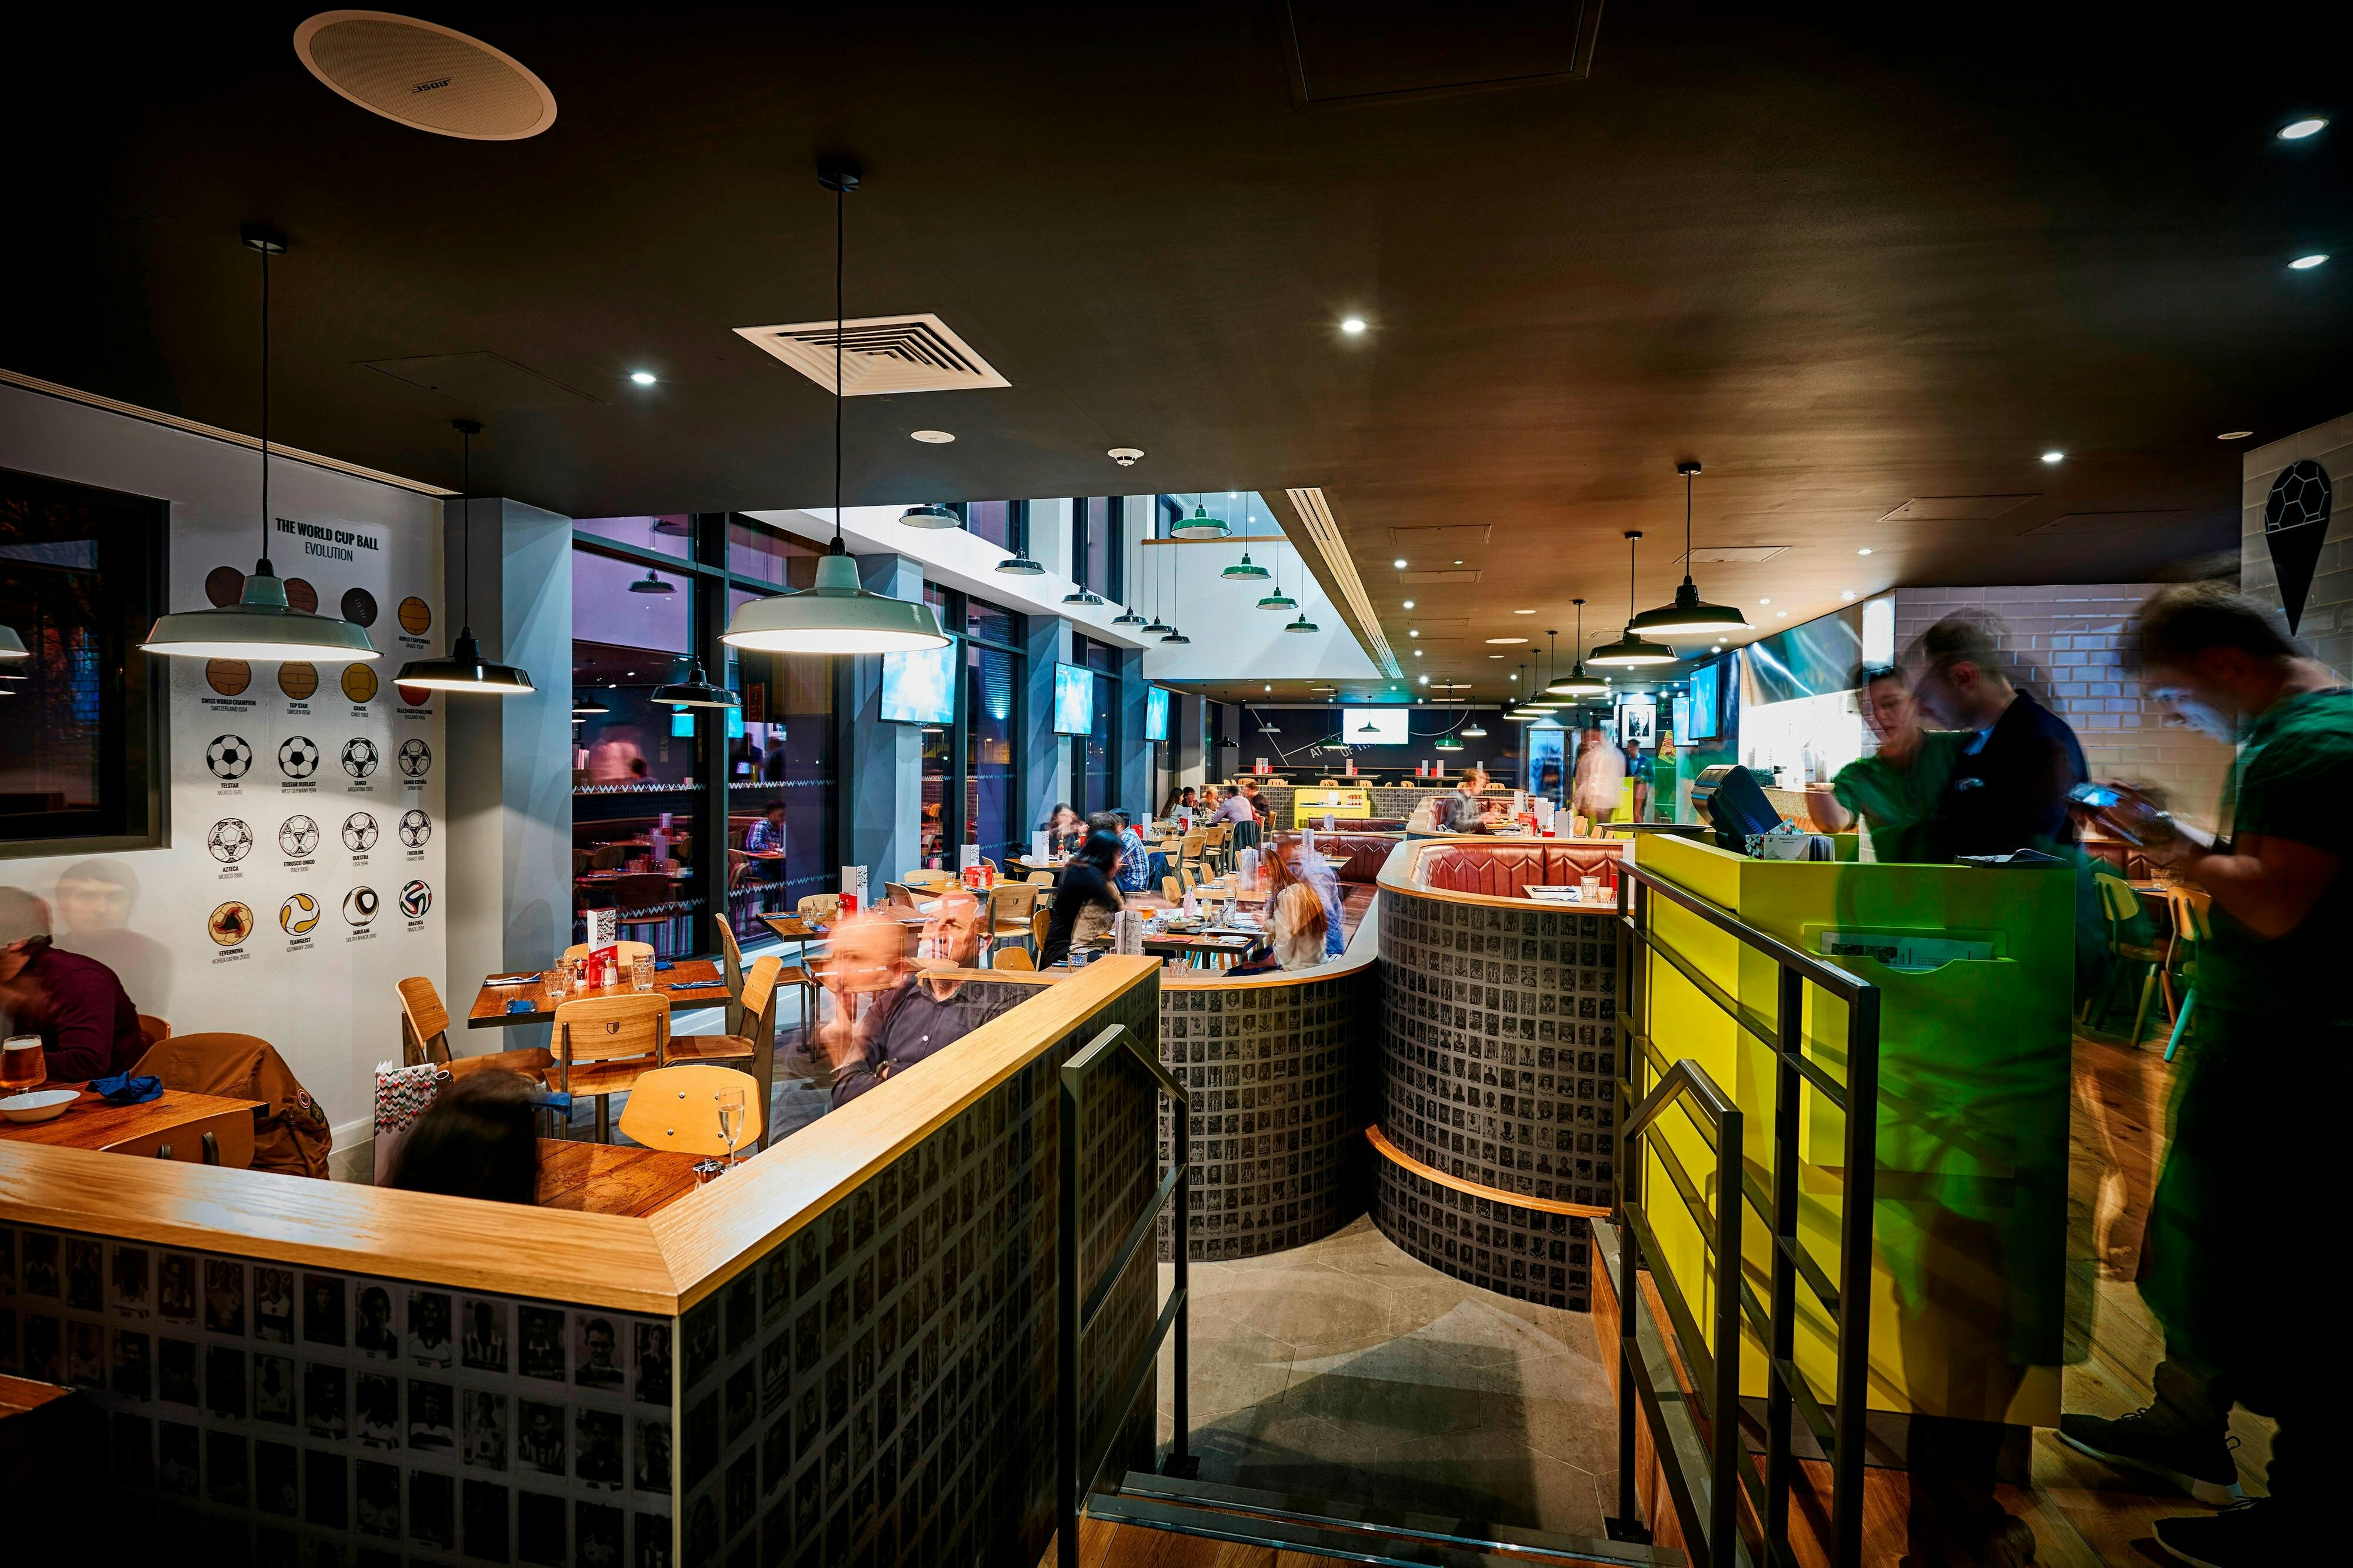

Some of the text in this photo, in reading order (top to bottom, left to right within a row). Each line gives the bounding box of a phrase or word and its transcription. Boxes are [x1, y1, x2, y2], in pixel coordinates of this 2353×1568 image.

[412, 77, 452, 93] BOSE
[275, 518, 379, 551] THE WORLD CUP BALL
[305, 542, 353, 562] EVOLUTION
[1310, 745, 1323, 758] AT
[289, 937, 311, 945] TEAMGEIST
[219, 948, 244, 956] FEVERNOVA
[212, 955, 239, 965] KOREA/JAPAN
